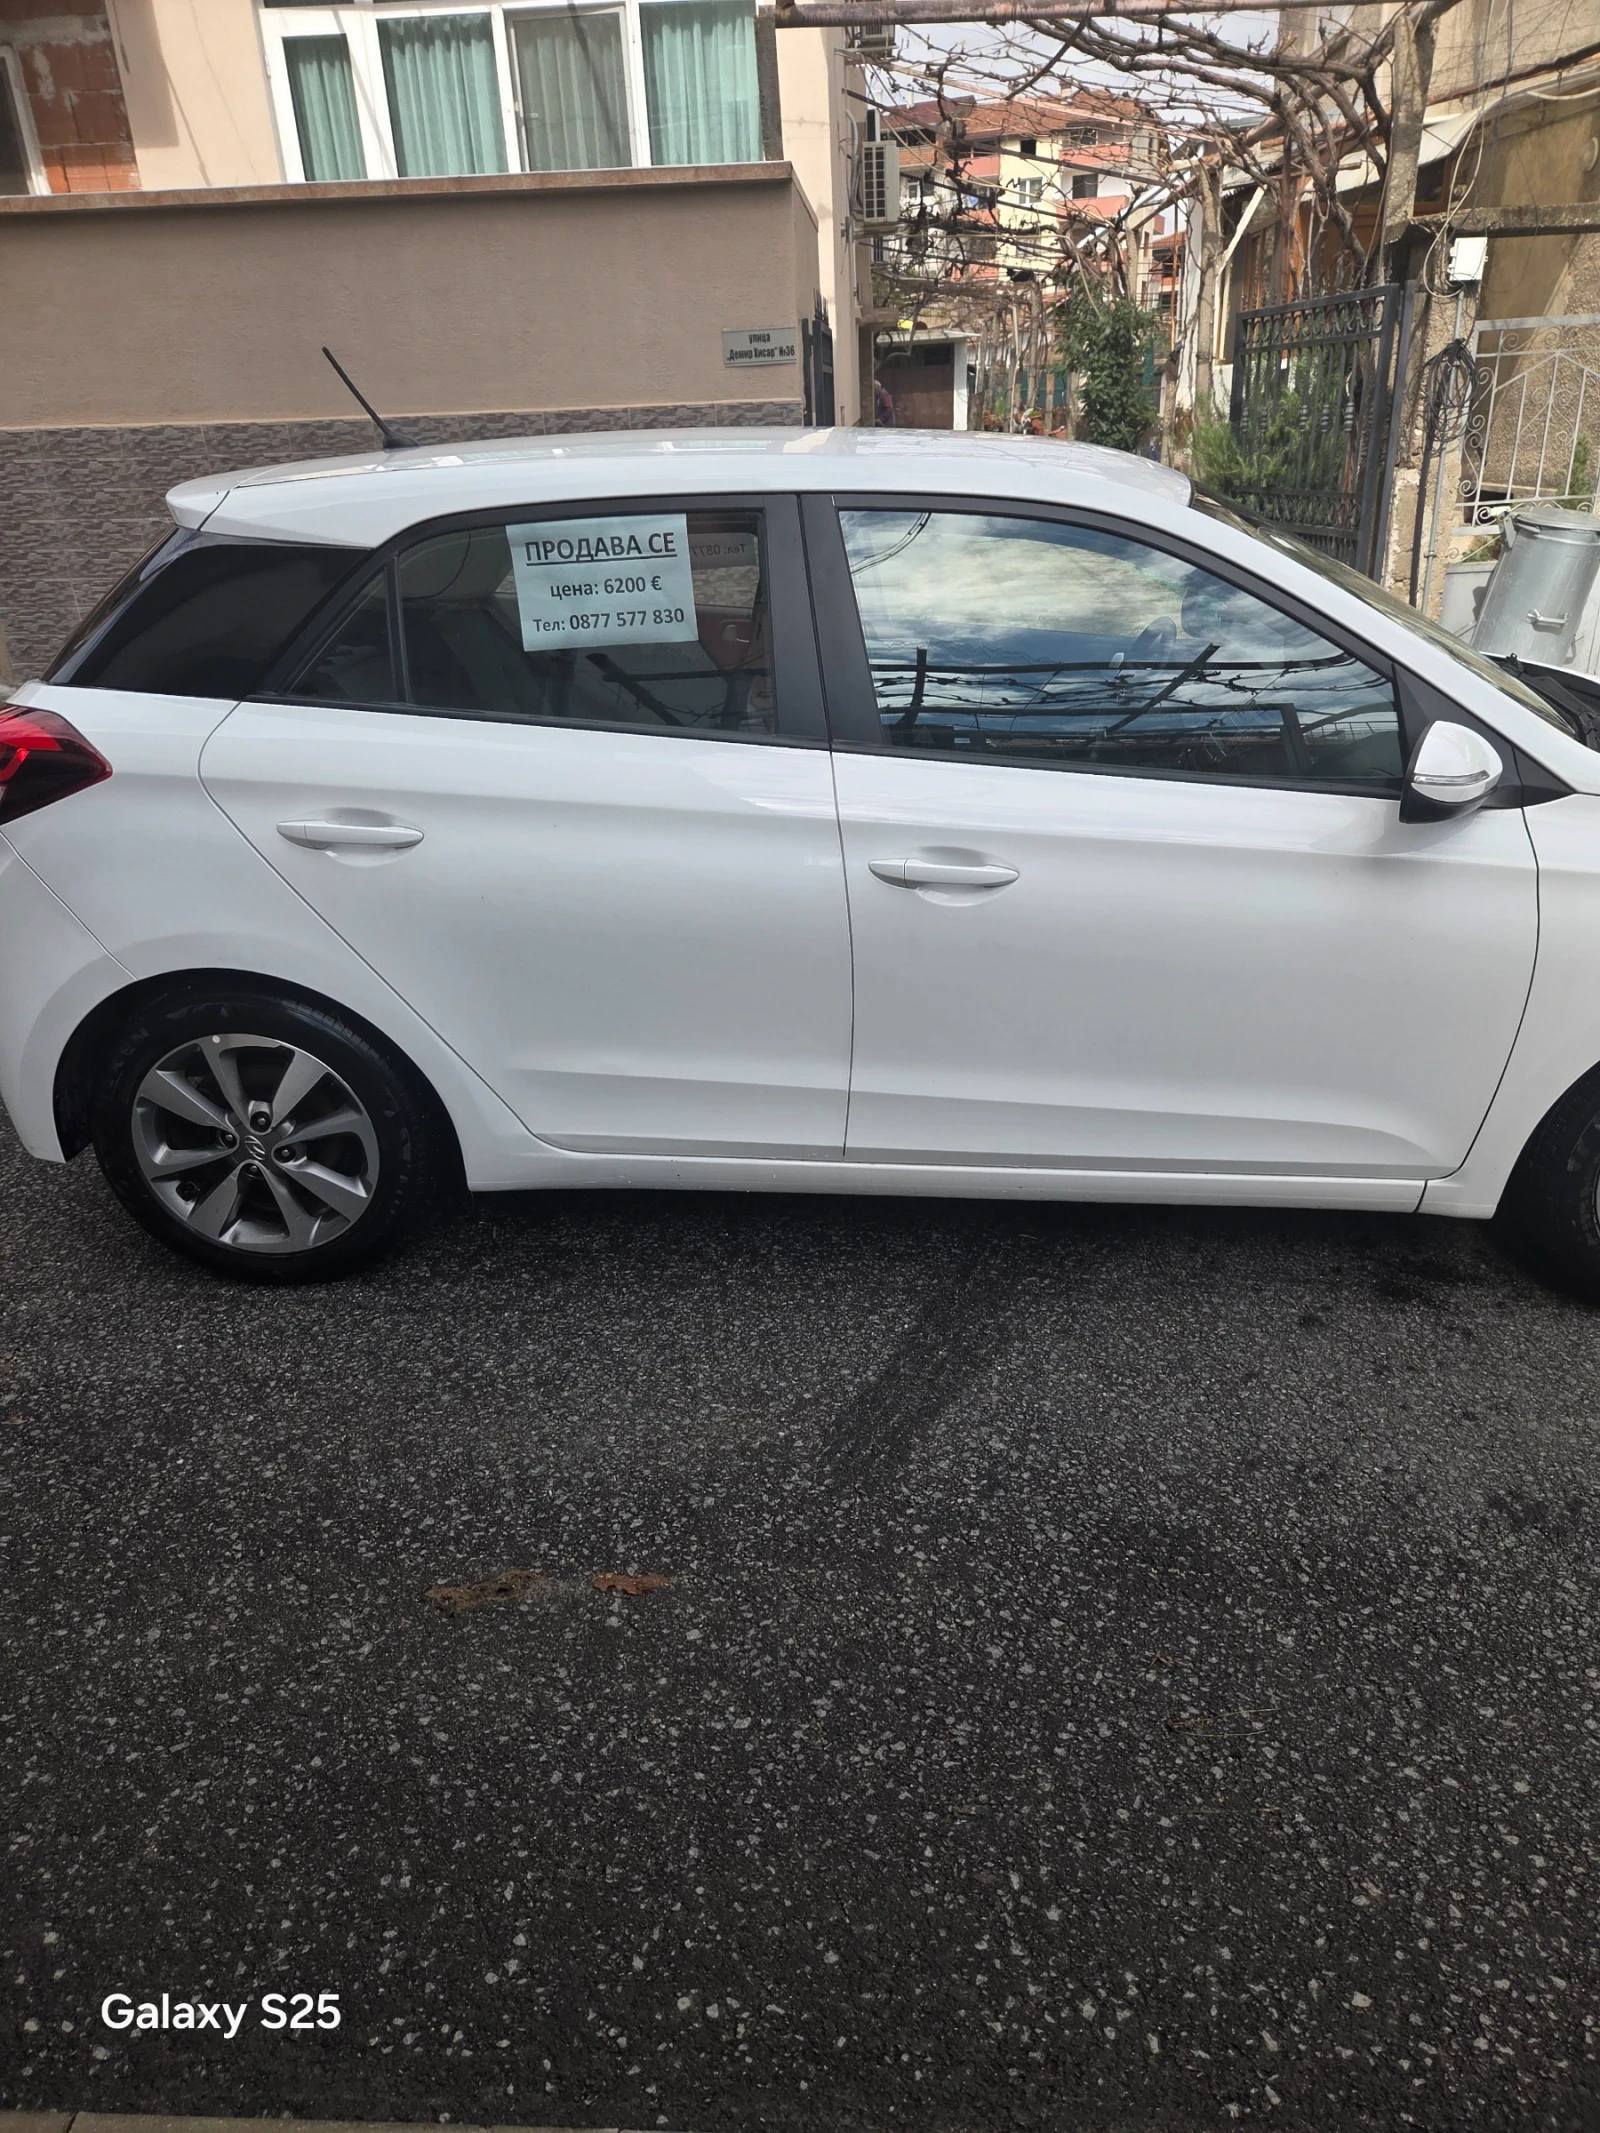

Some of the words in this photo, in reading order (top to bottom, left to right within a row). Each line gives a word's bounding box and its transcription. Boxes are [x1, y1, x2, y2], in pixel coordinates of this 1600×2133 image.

[748, 333, 771, 344] улица
[524, 534, 643, 562] ПРОДАВА
[648, 532, 676, 553] СЕ
[550, 582, 600, 600] цена:
[603, 576, 646, 594] 6200
[650, 575, 662, 591] €
[533, 618, 565, 632] Тел:
[569, 613, 611, 630] 0877
[616, 611, 647, 627] 577
[653, 608, 685, 625] 830
